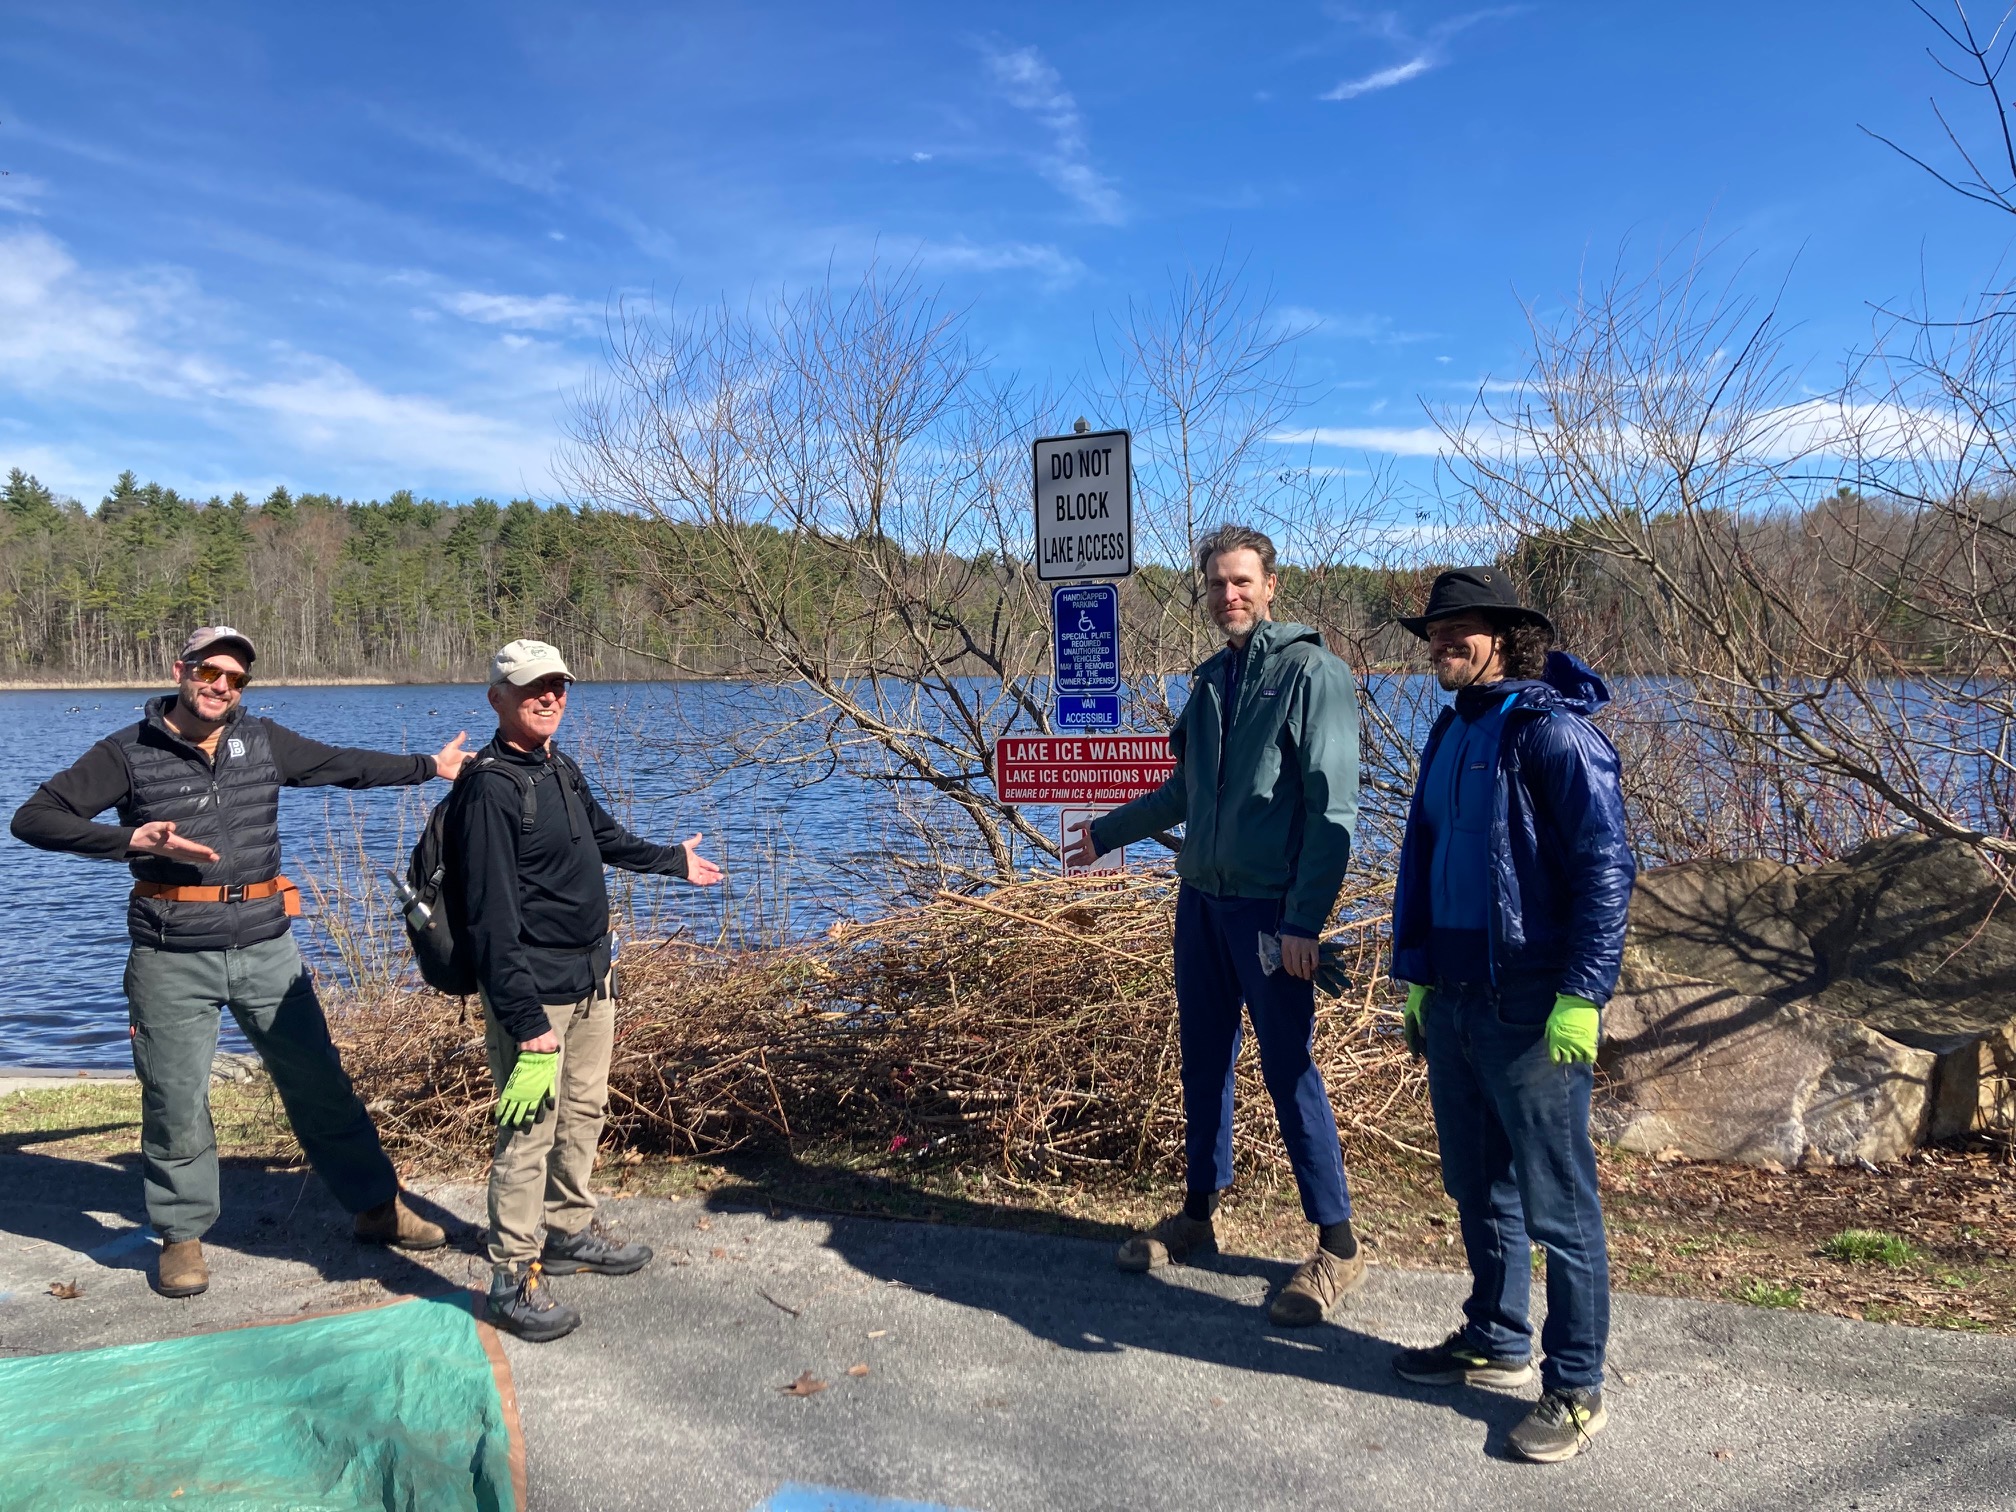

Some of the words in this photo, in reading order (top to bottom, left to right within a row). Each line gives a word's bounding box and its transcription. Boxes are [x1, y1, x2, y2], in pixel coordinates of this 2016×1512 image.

[1052, 452, 1073, 480] DO
[1080, 448, 1112, 478] NOT
[1056, 491, 1110, 521] BLOCK
[1044, 536, 1073, 564] LAKE
[1077, 532, 1124, 562] ACCESS
[1062, 592, 1108, 602] HANDICAPPED
[1072, 600, 1098, 608] PARKING
[1061, 632, 1089, 640] SPECIAL
[1091, 632, 1111, 640] PLATE
[1072, 640, 1102, 648] REQUIRED
[1064, 647, 1110, 655] UNAUTHORIZED
[1060, 678, 1086, 686] OWNER'S
[1089, 677, 1115, 685] EXPENSE
[1081, 699, 1096, 708] VAN
[1066, 713, 1112, 723] ACCESSIBLE
[228, 739, 245, 758] B
[1006, 742, 1049, 760] LAKE
[1055, 742, 1082, 760] ICE
[1006, 770, 1035, 782] LAKE
[1040, 770, 1058, 782] ICE
[1062, 769, 1139, 782] CONDITIONS
[1005, 788, 1038, 798] BEWARE
[1039, 788, 1049, 798] OF
[1051, 788, 1070, 798] THIN
[1071, 788, 1085, 798] ICE
[1086, 788, 1092, 798] &
[1095, 788, 1126, 798] HIDDEN
